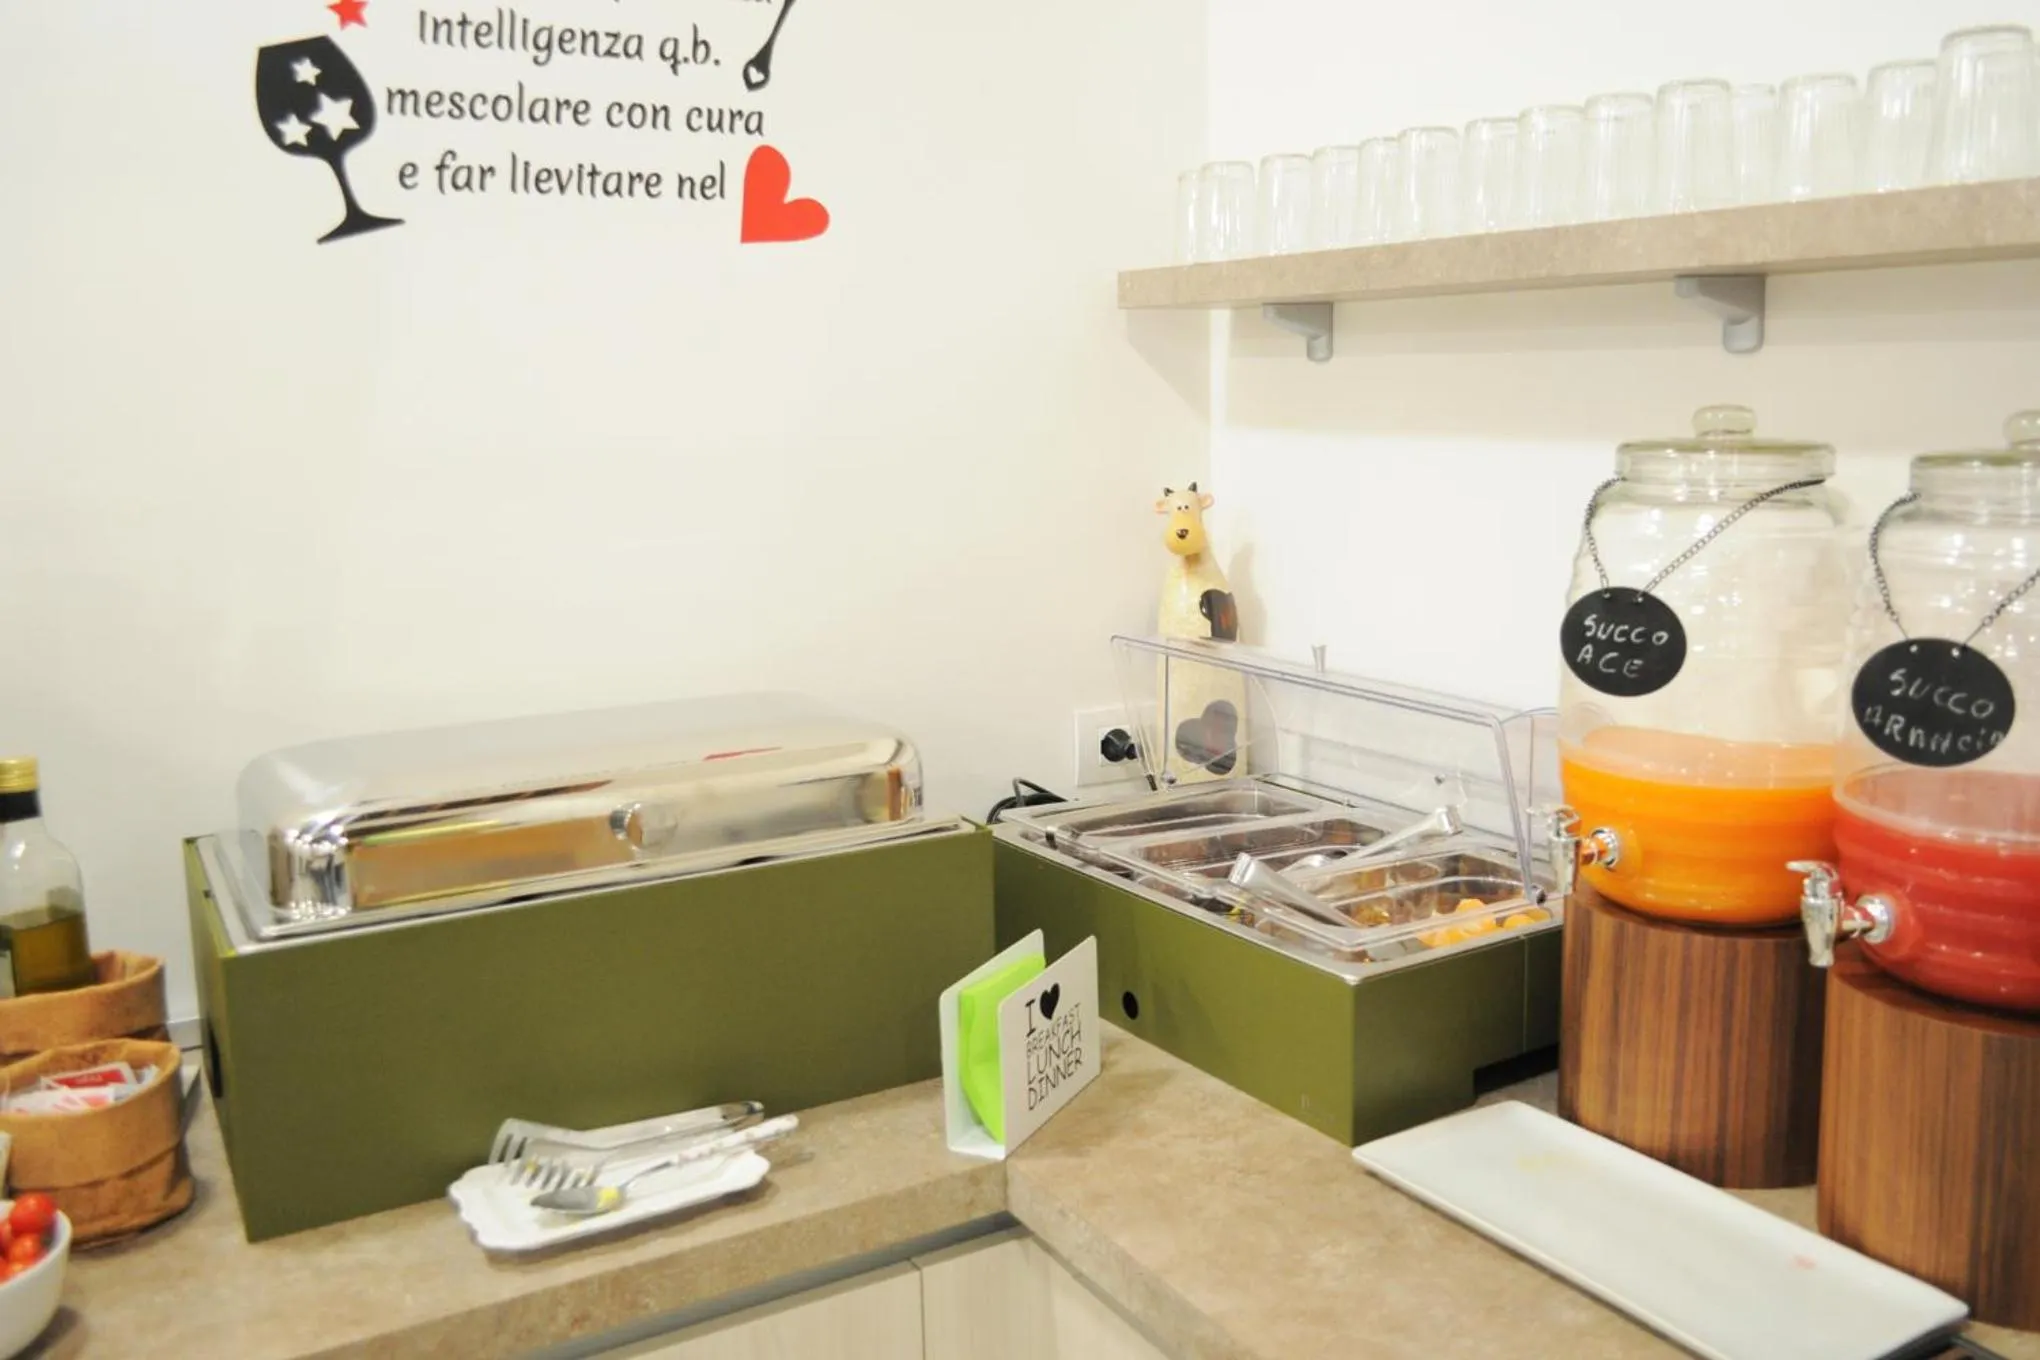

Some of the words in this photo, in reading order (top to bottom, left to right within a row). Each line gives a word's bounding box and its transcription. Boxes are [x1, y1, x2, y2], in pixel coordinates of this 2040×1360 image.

[658, 23, 721, 77] q.b.
[385, 86, 593, 132] mescolare
[605, 100, 678, 132] con
[685, 104, 763, 137] cura
[398, 161, 419, 191] e
[433, 148, 497, 195] far
[509, 151, 662, 200] lievitare
[676, 159, 726, 204] nel
[1583, 613, 1669, 646] SUCCO
[1576, 643, 1644, 679] ACE
[1889, 668, 1995, 719] SUCCO
[1025, 998, 1036, 1037] I
[1027, 1023, 1082, 1086] LUNCH
[1027, 1046, 1083, 1112] DINNER
